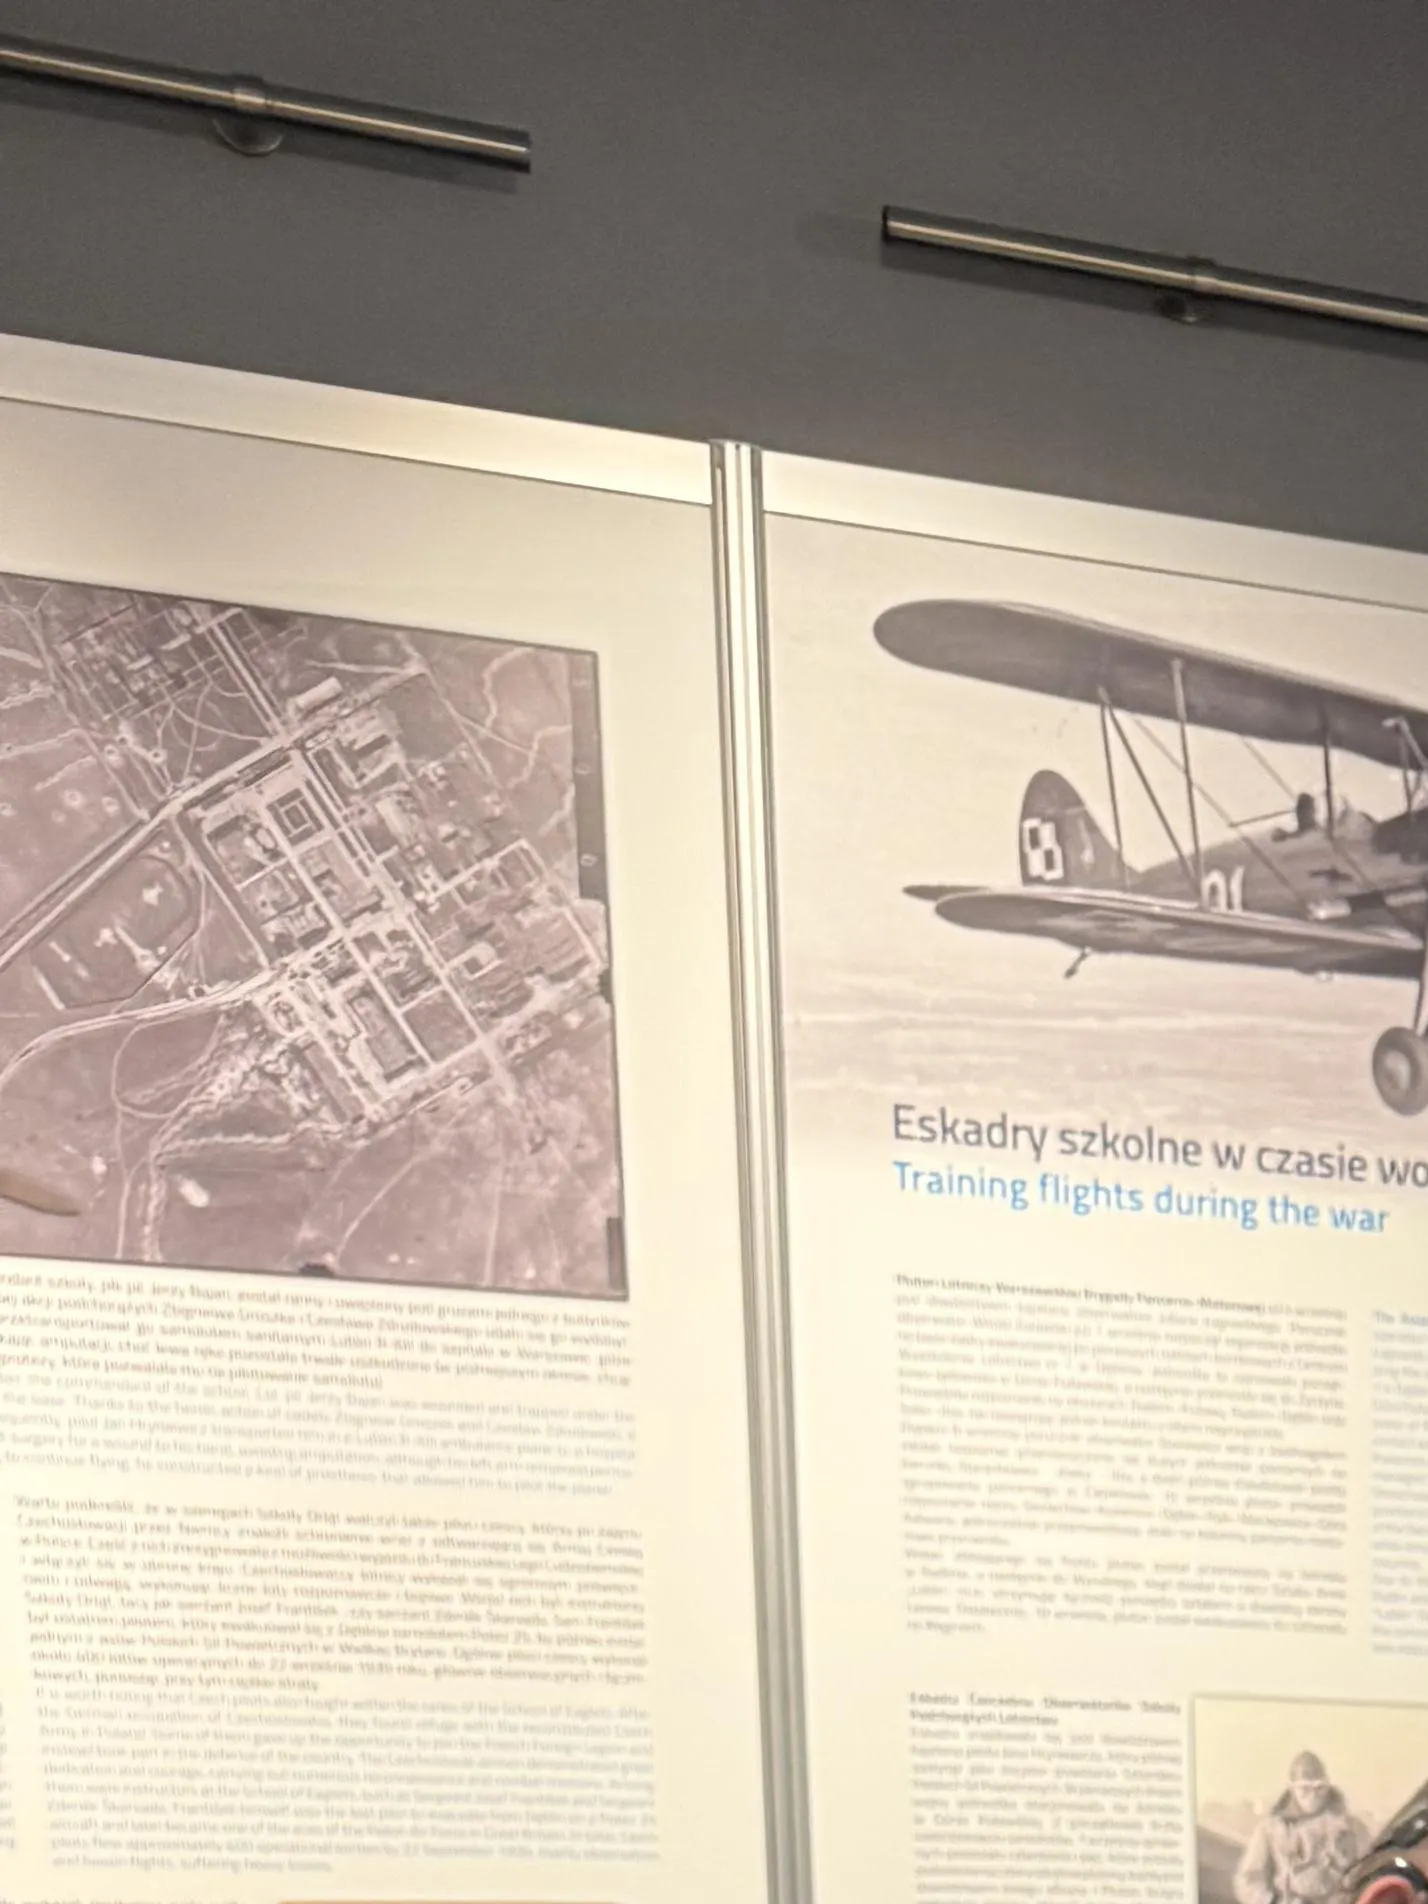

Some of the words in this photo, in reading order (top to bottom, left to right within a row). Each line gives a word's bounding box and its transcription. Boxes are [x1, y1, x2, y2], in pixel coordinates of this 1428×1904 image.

[893, 1102, 1048, 1163] Eskadry
[1058, 1120, 1202, 1167] szkolne
[1255, 1143, 1368, 1183] czasie
[892, 1160, 1029, 1211] Training
[1038, 1172, 1144, 1217] flights
[1154, 1184, 1258, 1231] during
[1267, 1194, 1320, 1227] the
[1329, 1208, 1390, 1233] war
